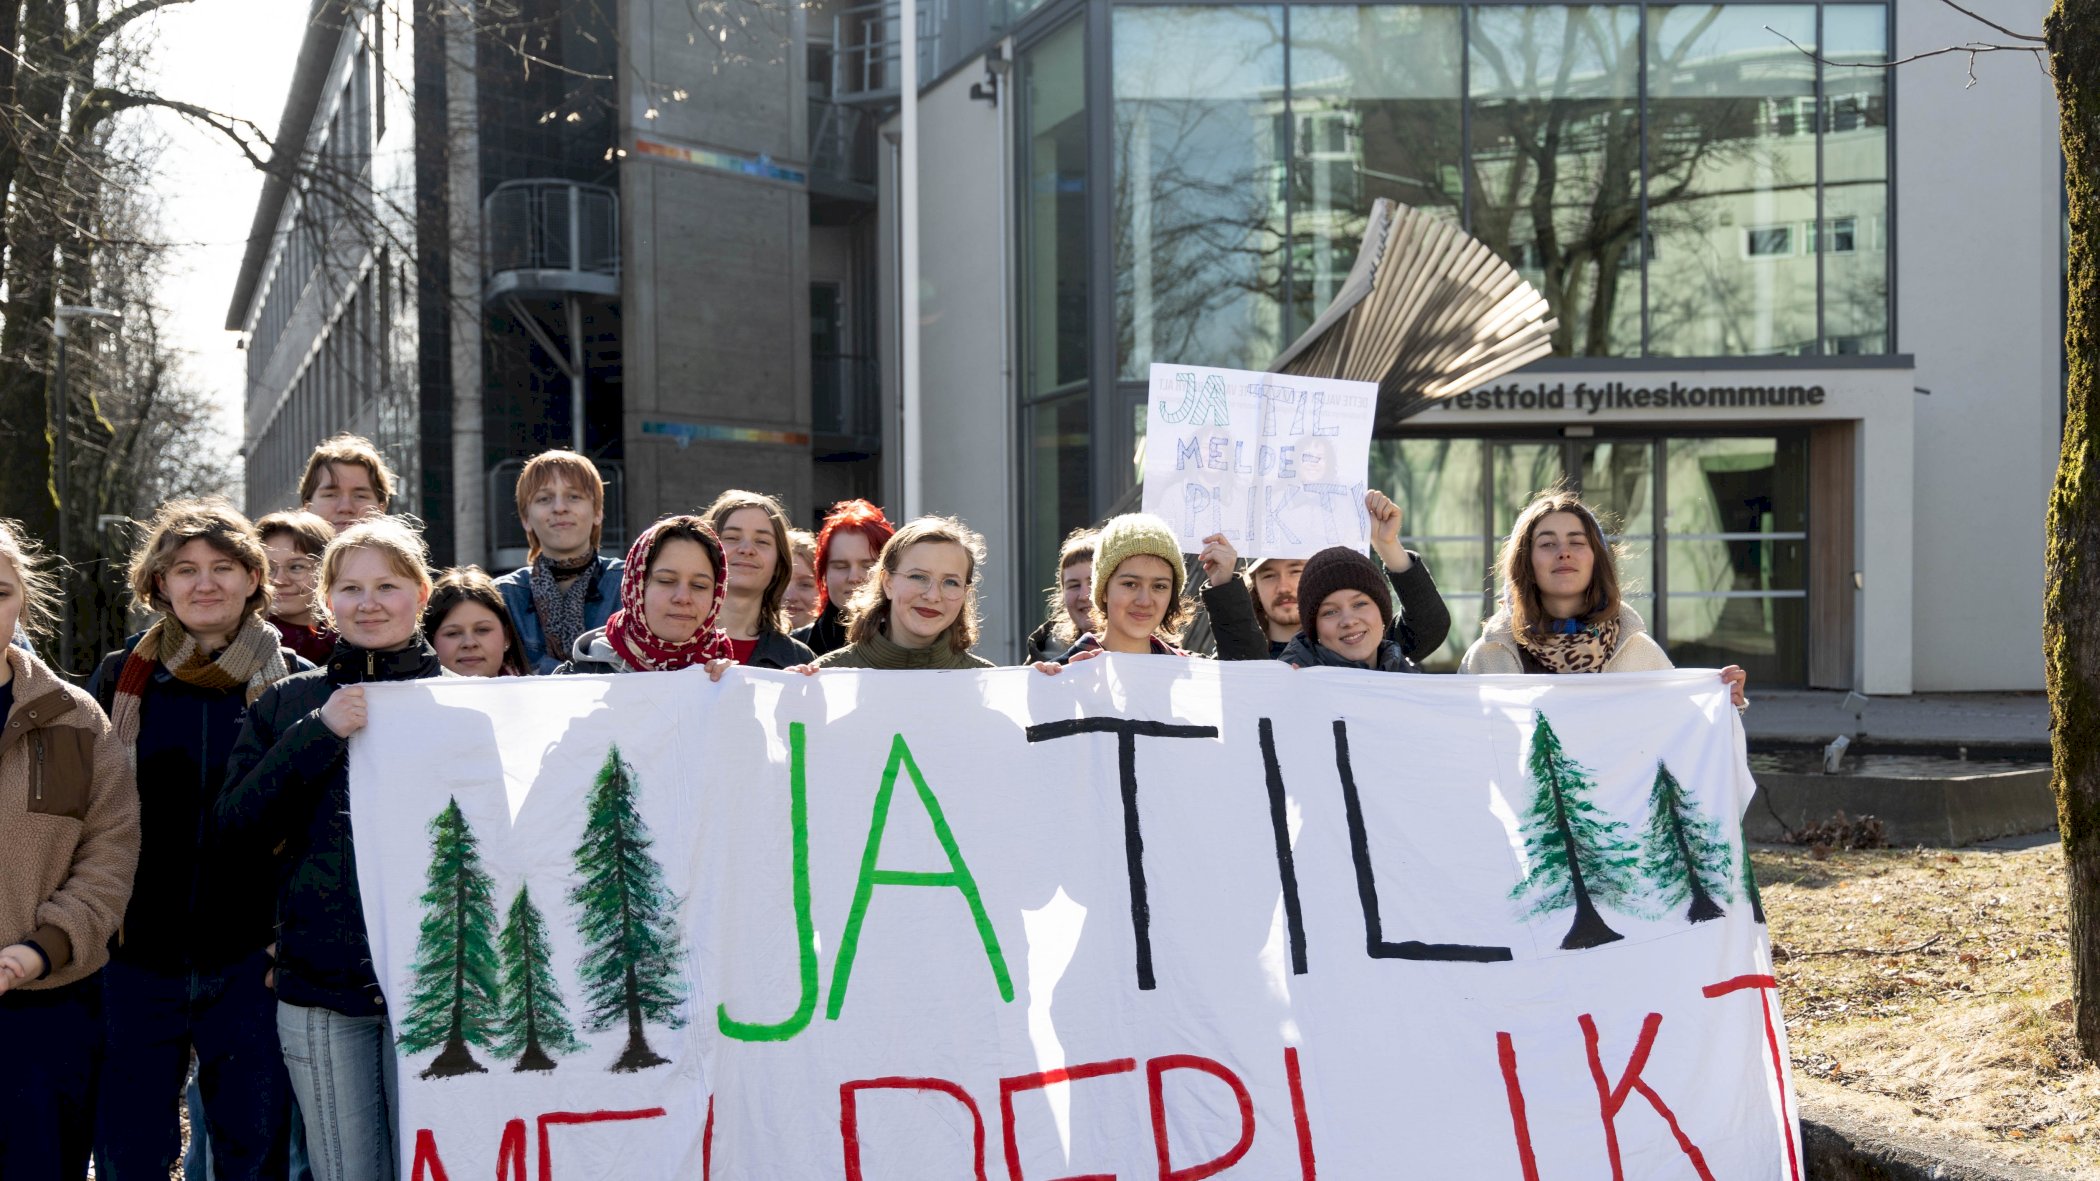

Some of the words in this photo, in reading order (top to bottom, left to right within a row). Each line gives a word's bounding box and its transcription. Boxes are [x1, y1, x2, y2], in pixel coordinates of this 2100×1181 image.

[1160, 372, 1229, 426] JA
[1247, 383, 1339, 437] TIL
[1573, 380, 1826, 415] fylkeskommune
[1176, 436, 1321, 479] MELDE-
[717, 721, 1015, 1042] JA
[1025, 716, 1513, 991] TIL
